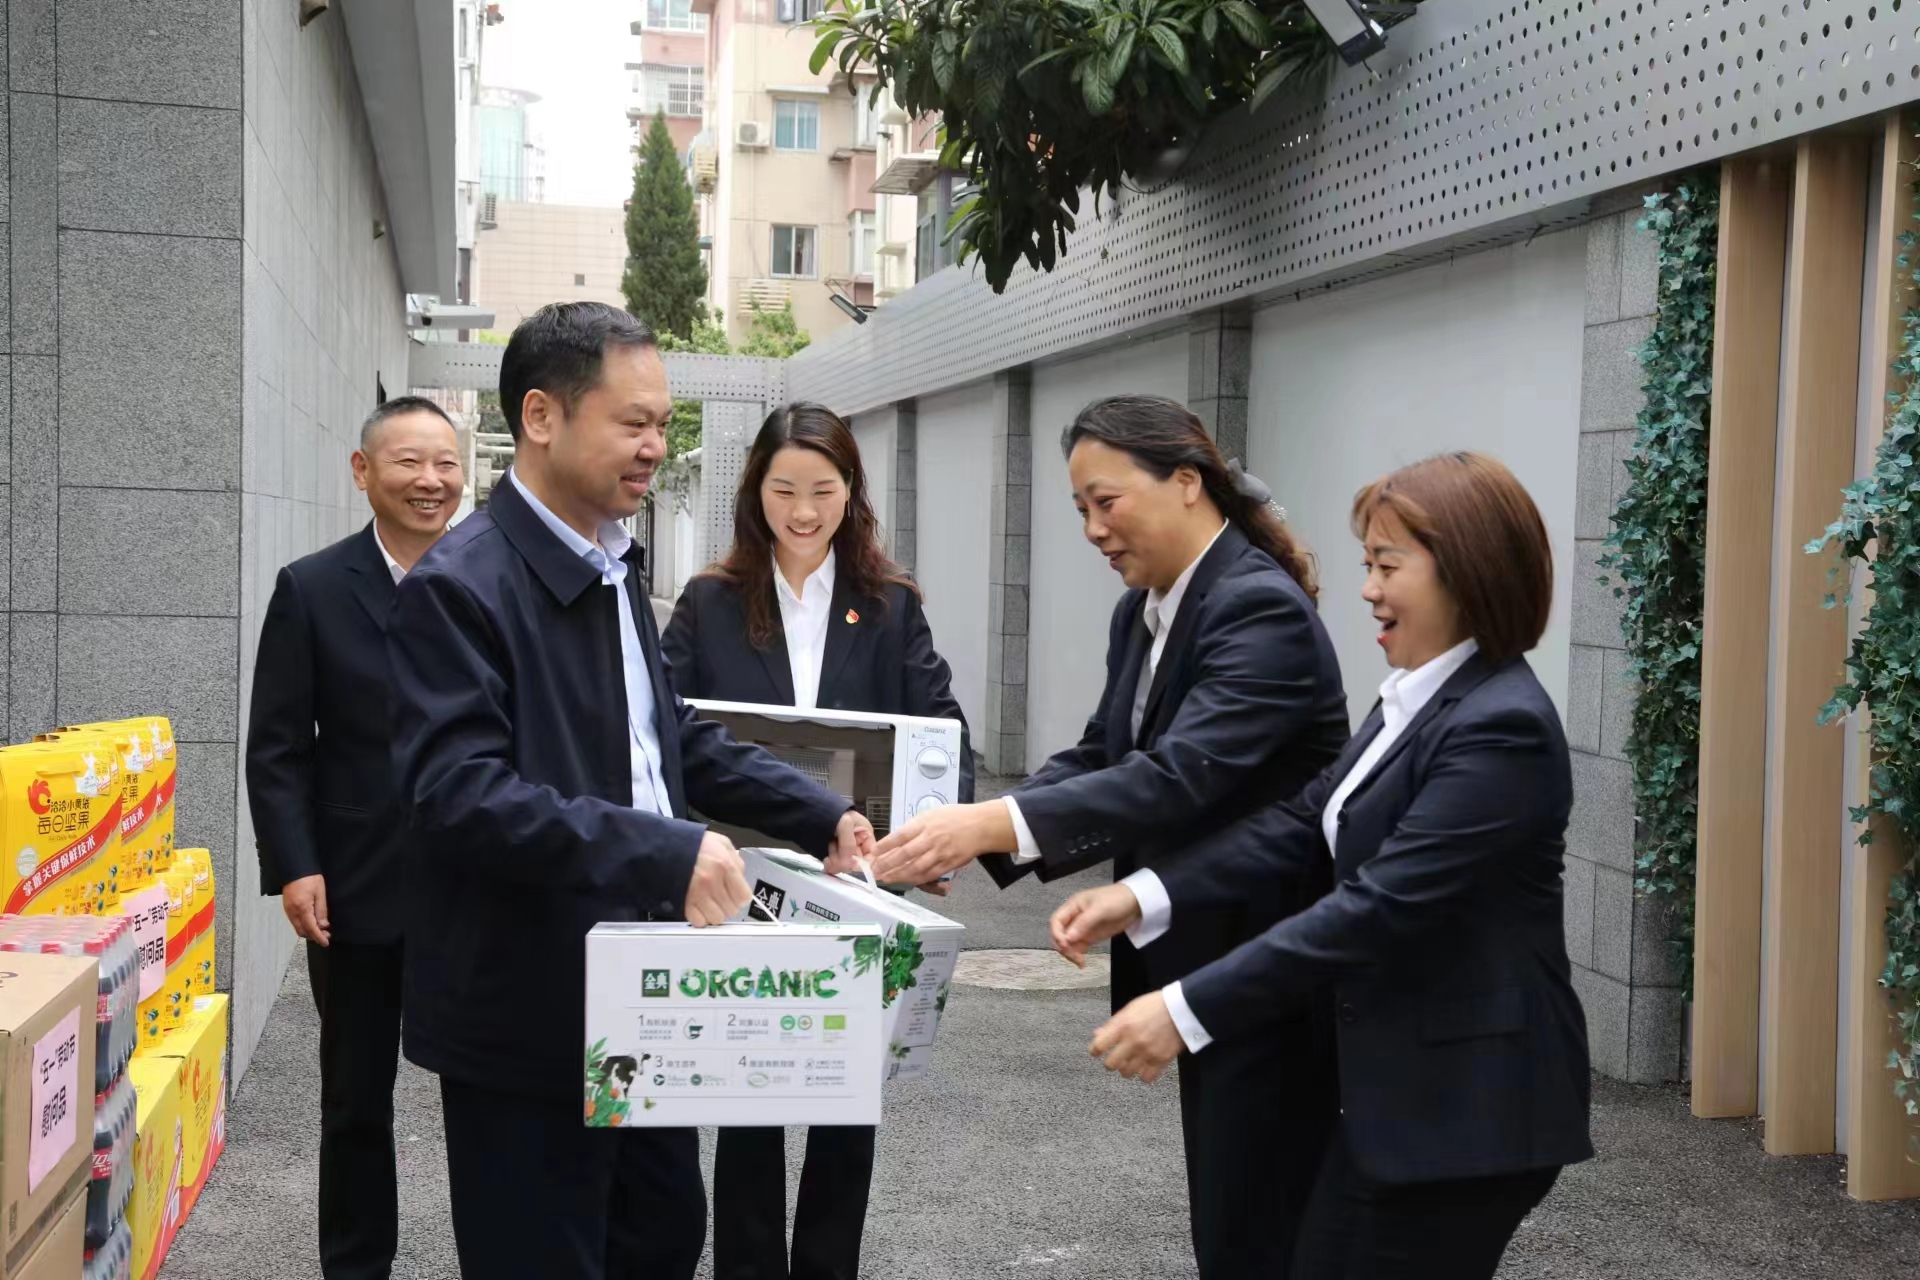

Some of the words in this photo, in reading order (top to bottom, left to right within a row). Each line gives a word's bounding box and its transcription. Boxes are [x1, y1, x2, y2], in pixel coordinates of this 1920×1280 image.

[51, 797, 90, 813] 洽洽小黄袋
[37, 811, 90, 835] 每日坚果
[120, 806, 145, 834] 鲜技术
[22, 834, 96, 897] 掌握关键保鲜技术
[643, 972, 669, 990] 金典
[676, 966, 841, 999] ORGANIC
[727, 1013, 737, 1027] 2
[655, 1055, 664, 1068] 3
[738, 1055, 748, 1067] 4
[41, 1085, 67, 1139] 慰问品
